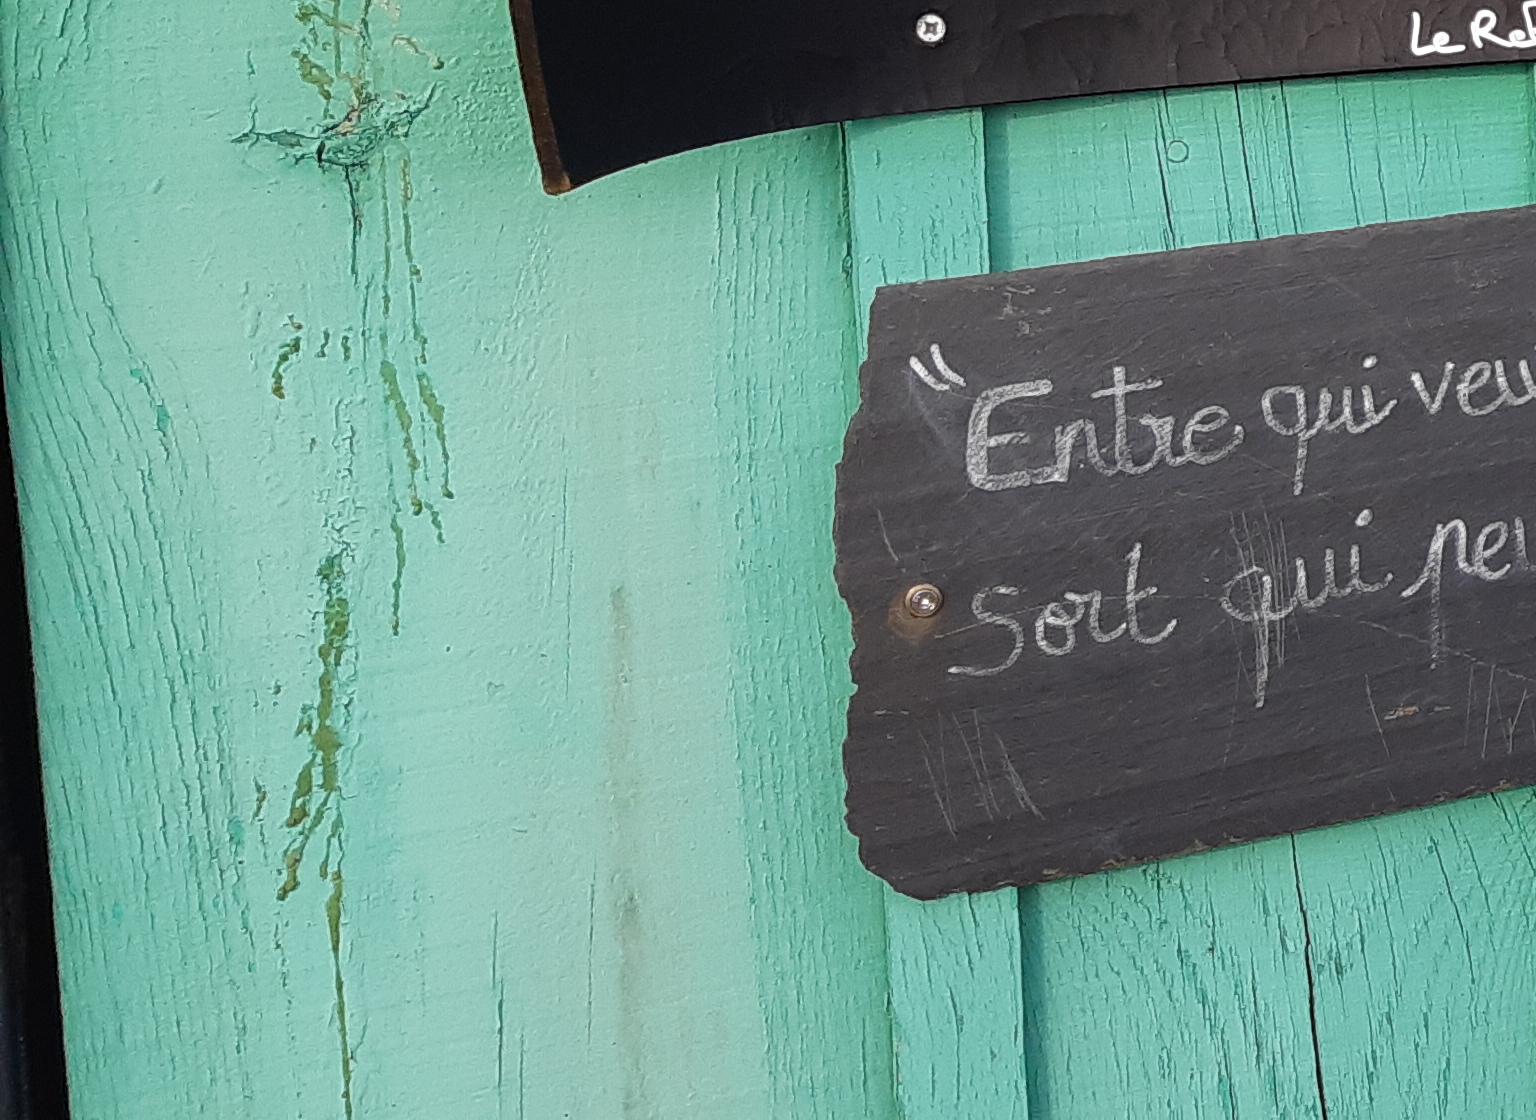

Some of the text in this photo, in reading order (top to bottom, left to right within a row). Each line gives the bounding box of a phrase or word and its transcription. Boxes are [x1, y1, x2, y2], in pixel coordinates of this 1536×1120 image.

[1410, 11, 1466, 56] Le
[1261, 356, 1398, 496] qui
[1222, 509, 1393, 708] qui
